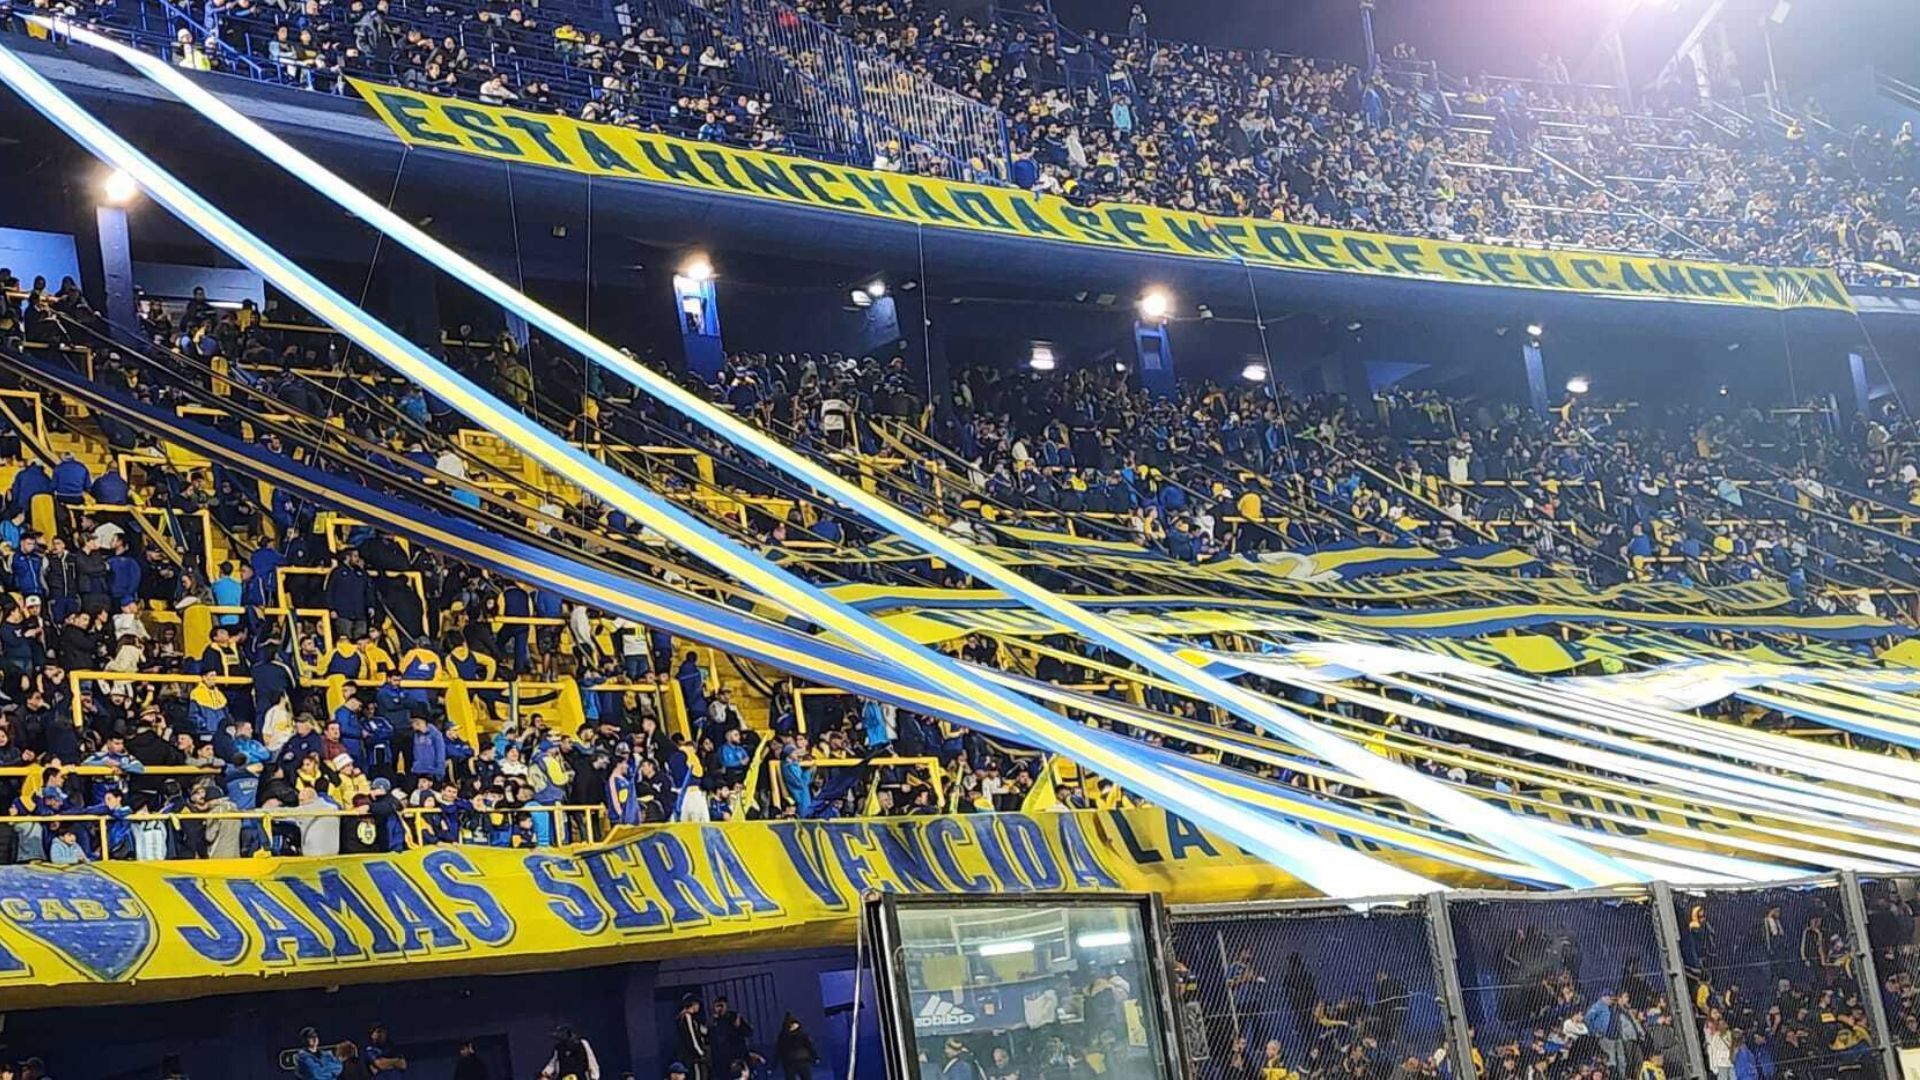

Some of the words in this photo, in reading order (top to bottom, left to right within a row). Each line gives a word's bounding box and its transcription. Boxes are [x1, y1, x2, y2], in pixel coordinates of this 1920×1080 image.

[376, 90, 638, 171] ESTA
[637, 139, 1064, 235] HINCHADA
[1064, 206, 1171, 248] SE
[1165, 217, 1446, 275] MERECE
[1438, 247, 1576, 288] SER
[163, 850, 515, 964] JAMAS
[523, 827, 783, 936] SERA
[774, 812, 1120, 912] VENCIDA
[1109, 809, 1221, 864] LA
[1, 897, 143, 921] CABJ
